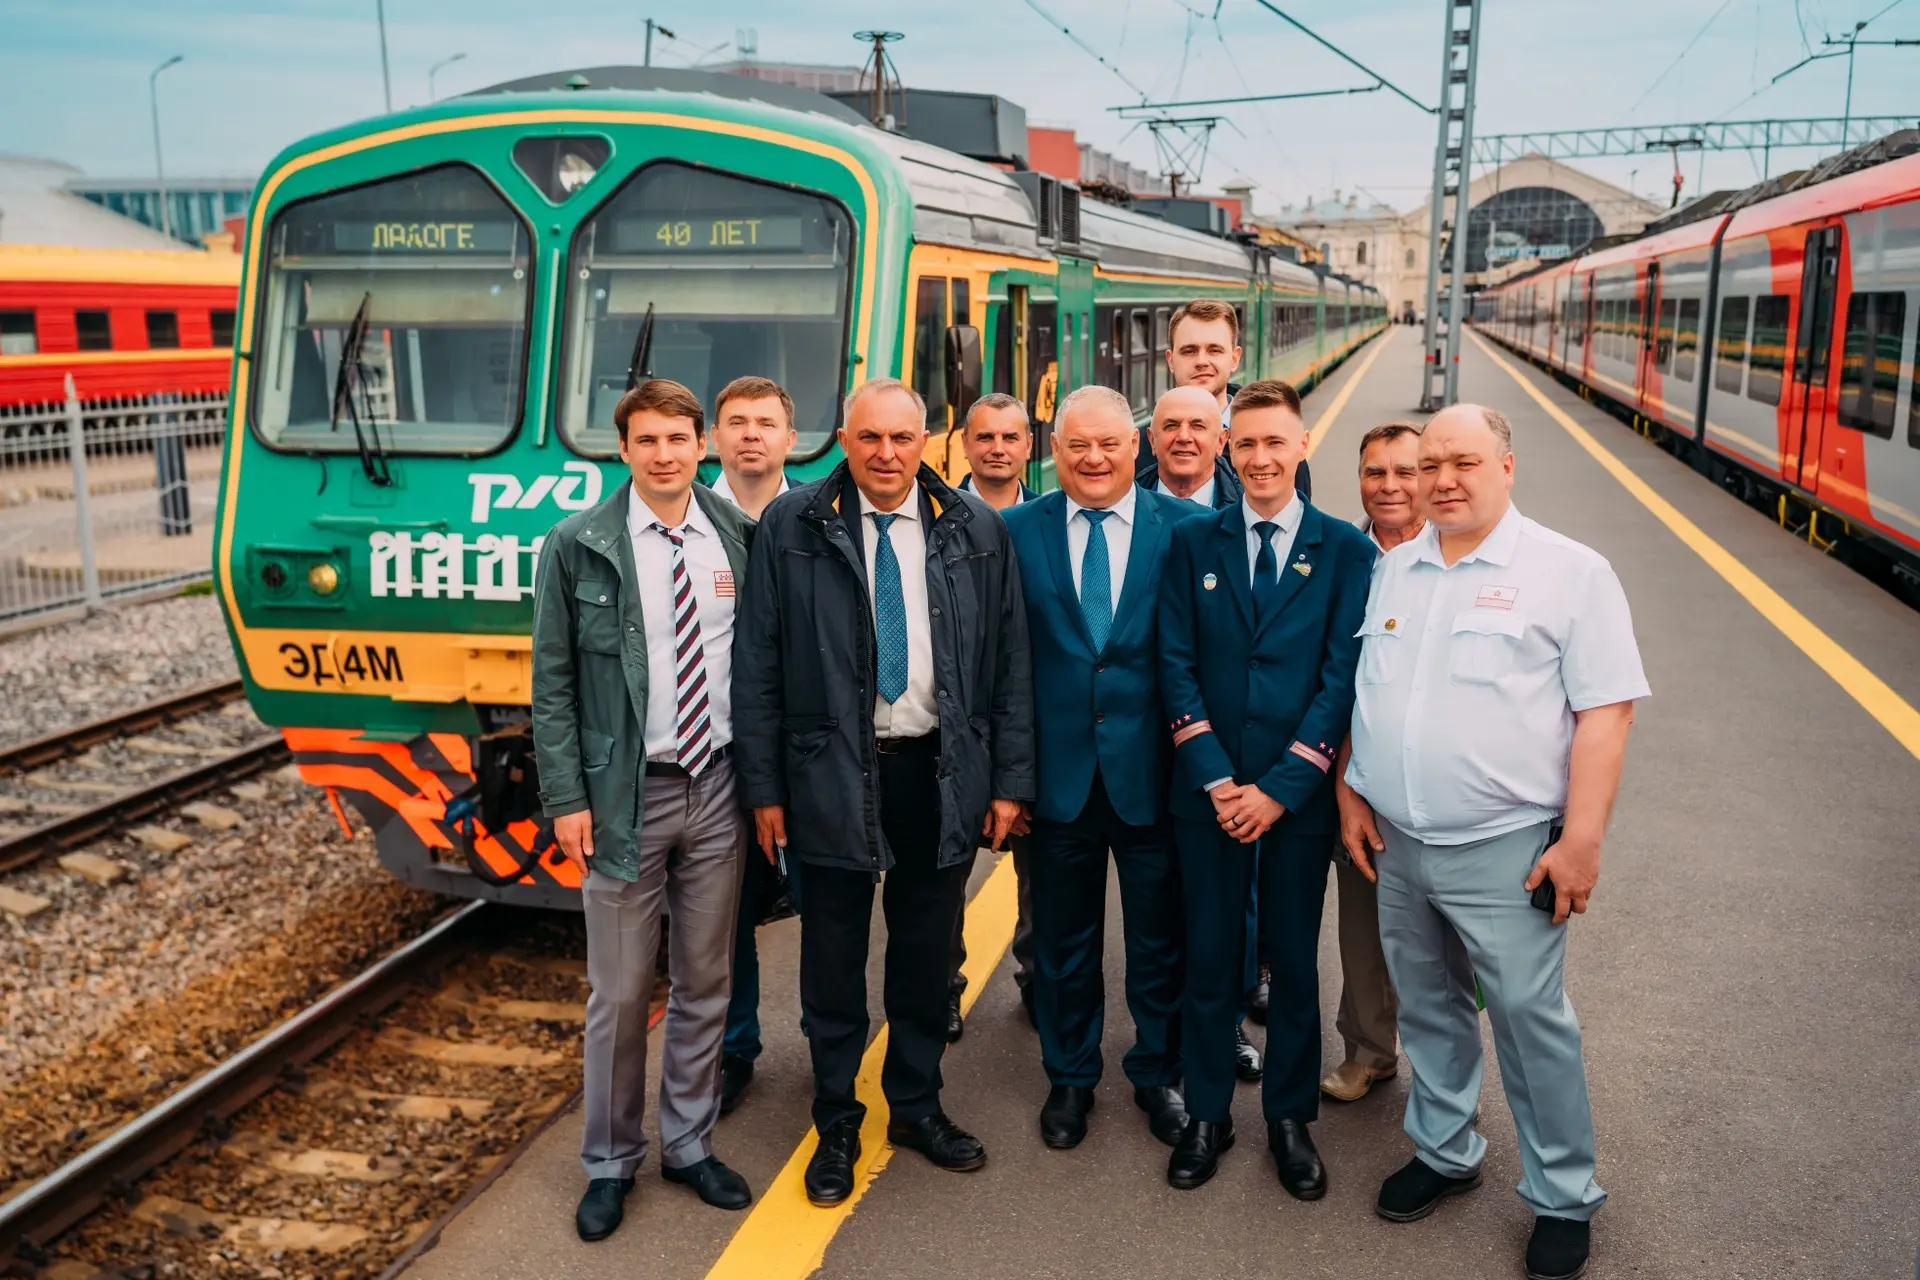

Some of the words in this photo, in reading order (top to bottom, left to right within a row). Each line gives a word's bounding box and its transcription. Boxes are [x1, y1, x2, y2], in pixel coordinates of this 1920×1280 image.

[656, 221, 692, 246] 40
[709, 219, 762, 246] ЛЕТ
[467, 460, 603, 524] РЖД
[369, 530, 545, 602] ЛАД
[279, 642, 404, 687] ЭД4М
